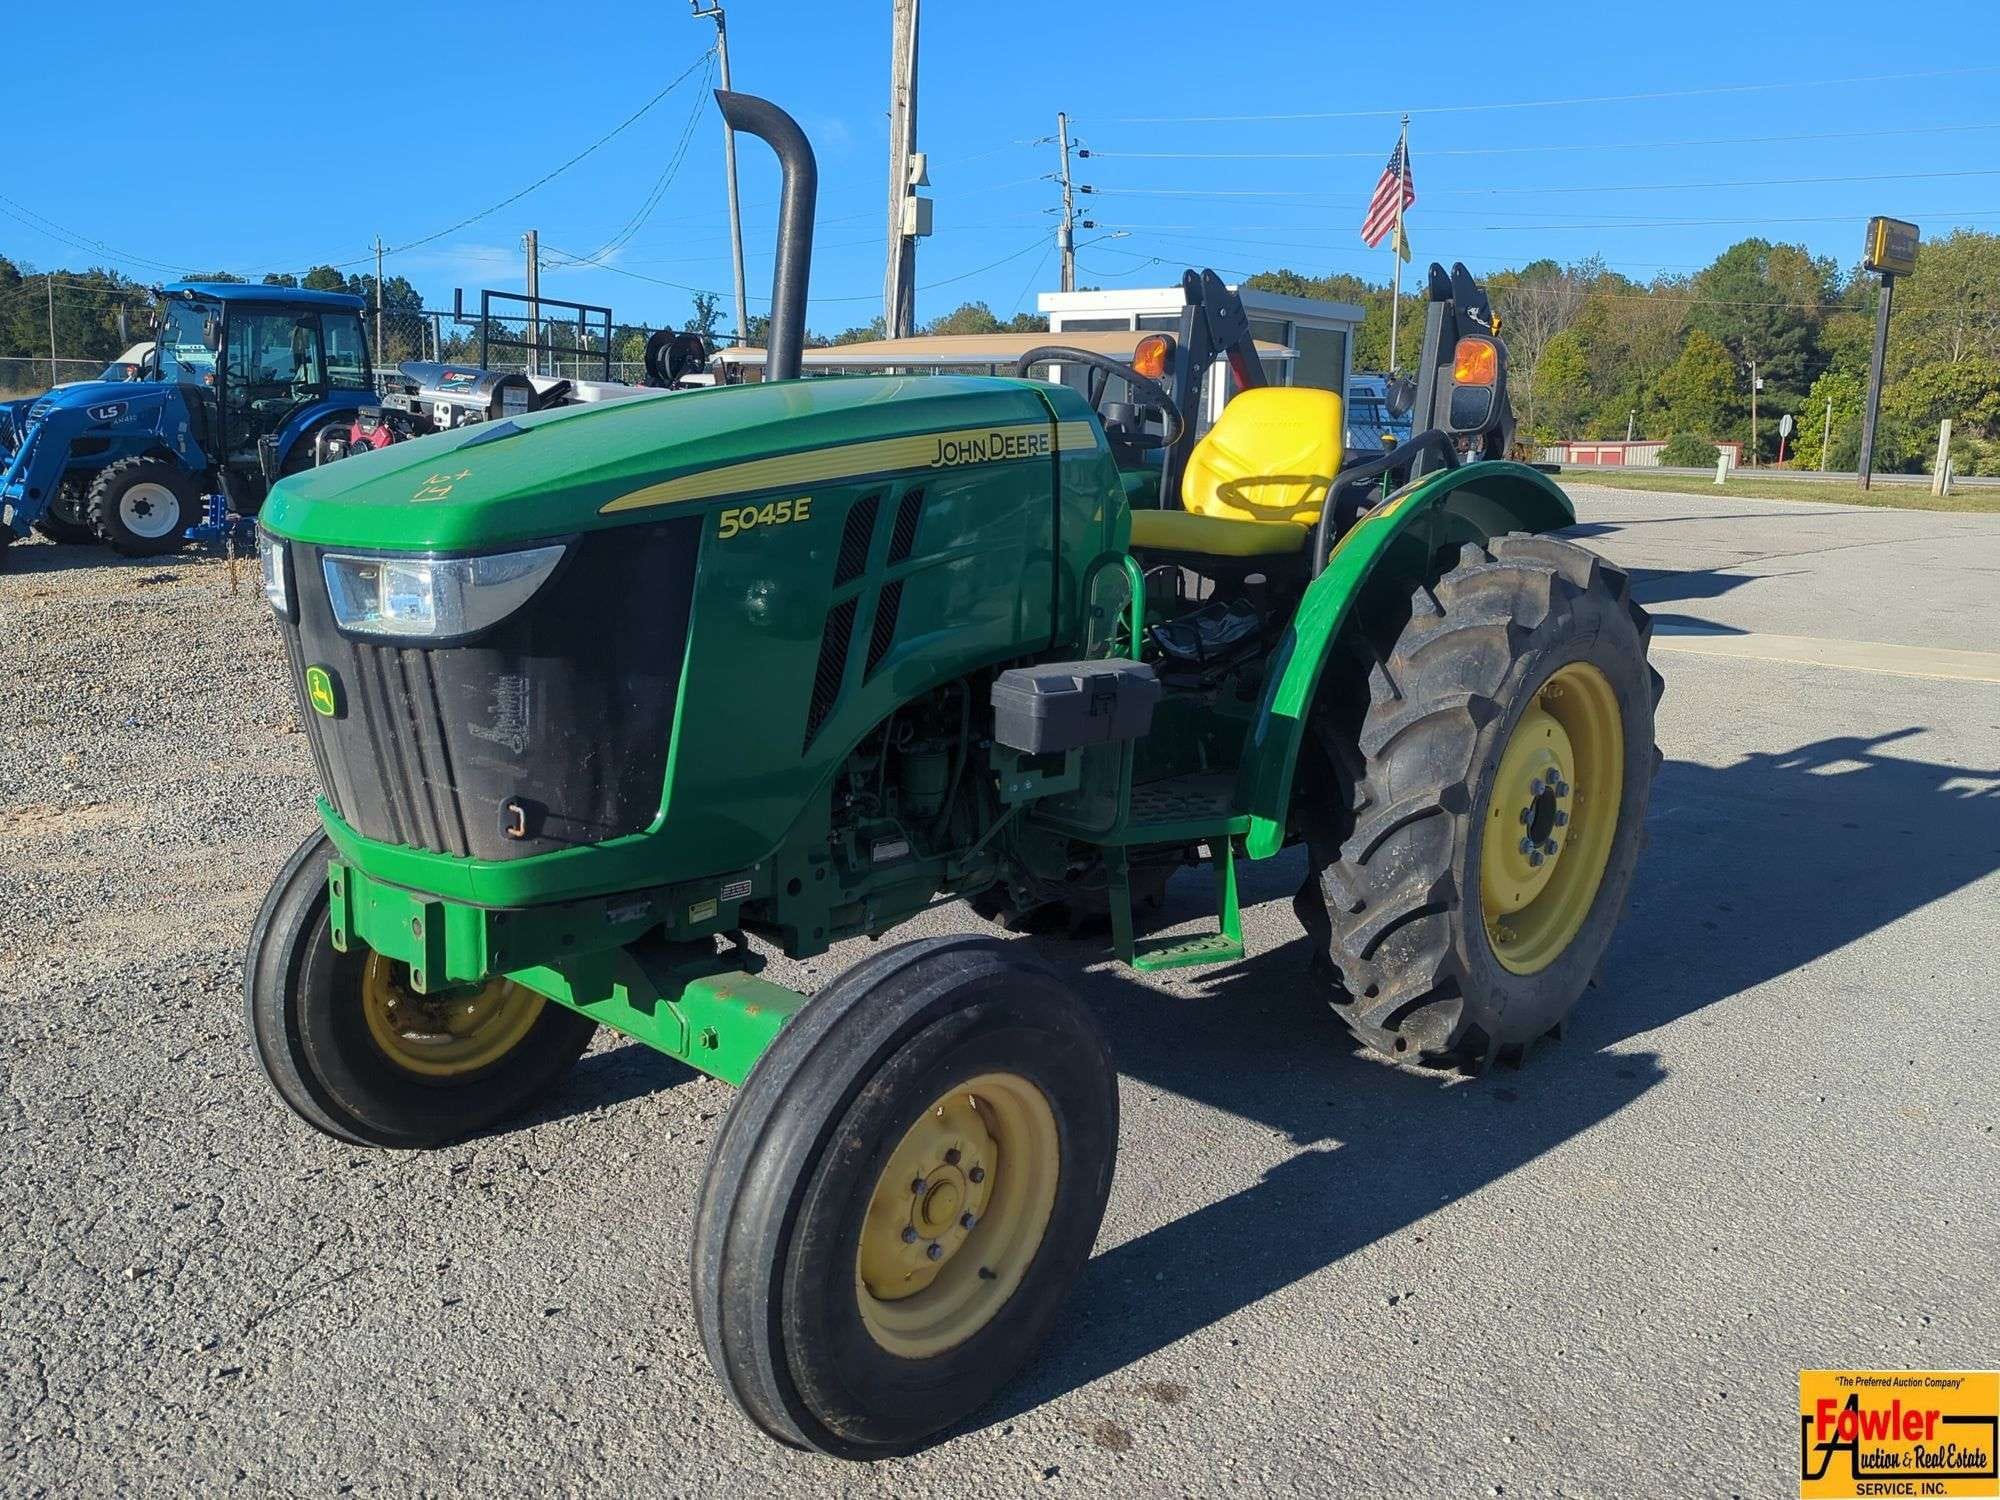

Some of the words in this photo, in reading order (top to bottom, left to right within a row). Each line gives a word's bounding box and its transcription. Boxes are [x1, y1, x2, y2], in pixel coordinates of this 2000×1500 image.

[99, 405, 118, 419] LS
[931, 438, 987, 465] JOHN
[990, 433, 1049, 457] DEERE
[718, 496, 812, 539] 5045E
